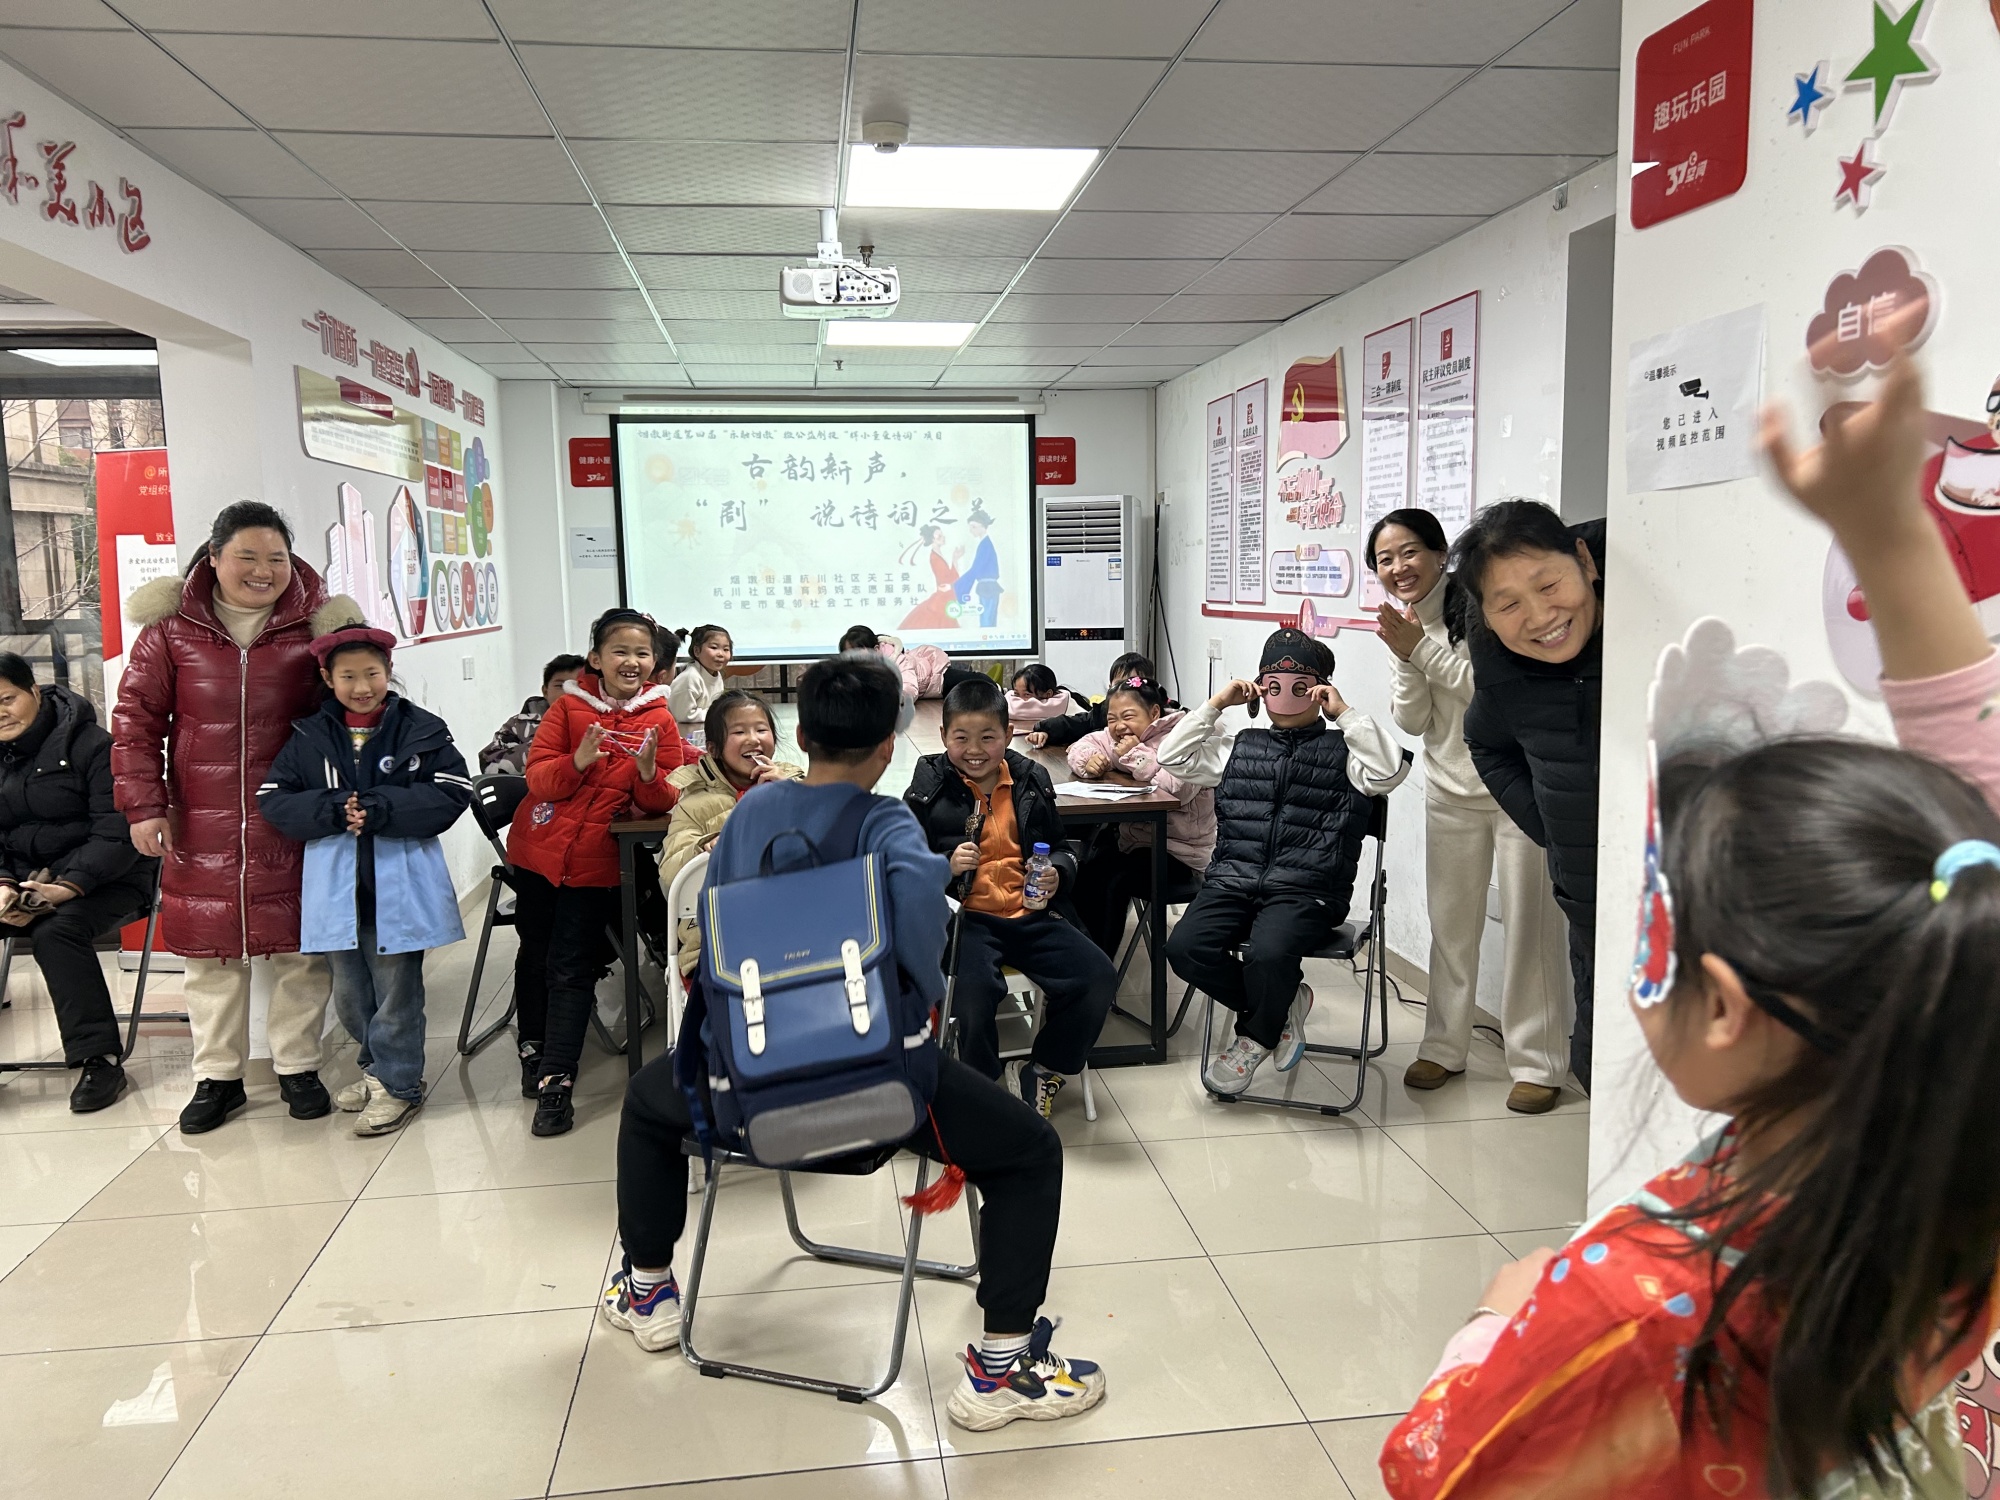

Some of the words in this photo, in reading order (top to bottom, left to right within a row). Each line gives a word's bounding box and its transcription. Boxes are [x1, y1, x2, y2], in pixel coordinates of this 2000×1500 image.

[1673, 38, 1689, 55] FUN
[1690, 26, 1711, 46] PARK
[1653, 70, 1727, 133] 趣玩乐园
[1836, 291, 1897, 343] 自信
[1422, 356, 1471, 383] 民主评议党员制度
[1648, 364, 1677, 381] 温馨提示
[1371, 379, 1402, 399] 三会一课制度
[1662, 406, 1718, 430] 您已进入
[1656, 425, 1725, 451] 视频监控范围
[1038, 455, 1068, 463] 阅读时光
[138, 484, 172, 496] 党组织
[155, 532, 174, 542] 致全
